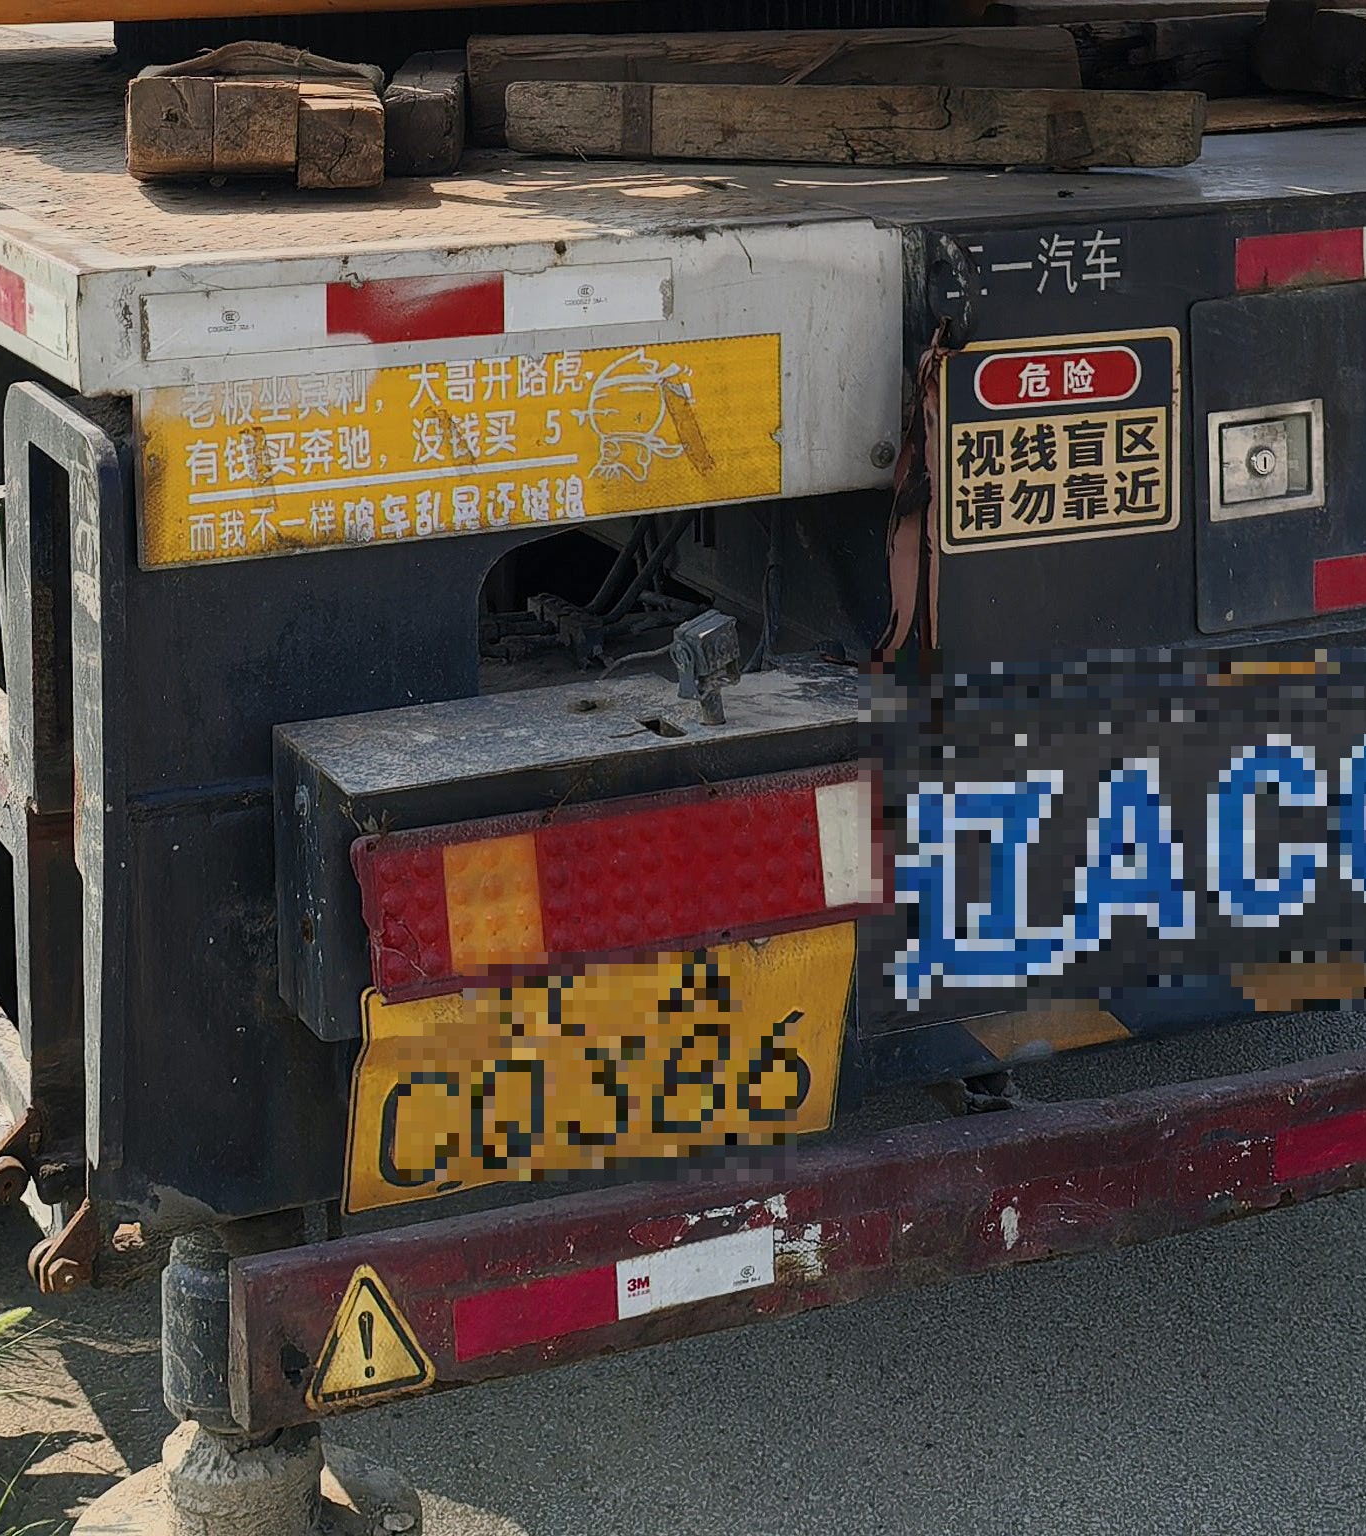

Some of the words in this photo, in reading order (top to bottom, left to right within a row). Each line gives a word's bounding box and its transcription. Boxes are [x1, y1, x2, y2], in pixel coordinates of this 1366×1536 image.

[1017, 358, 1096, 399] 危险
[956, 415, 1160, 480] 视线盲区
[955, 466, 1160, 532] 请勿靠近
[627, 1275, 650, 1292] 3M
